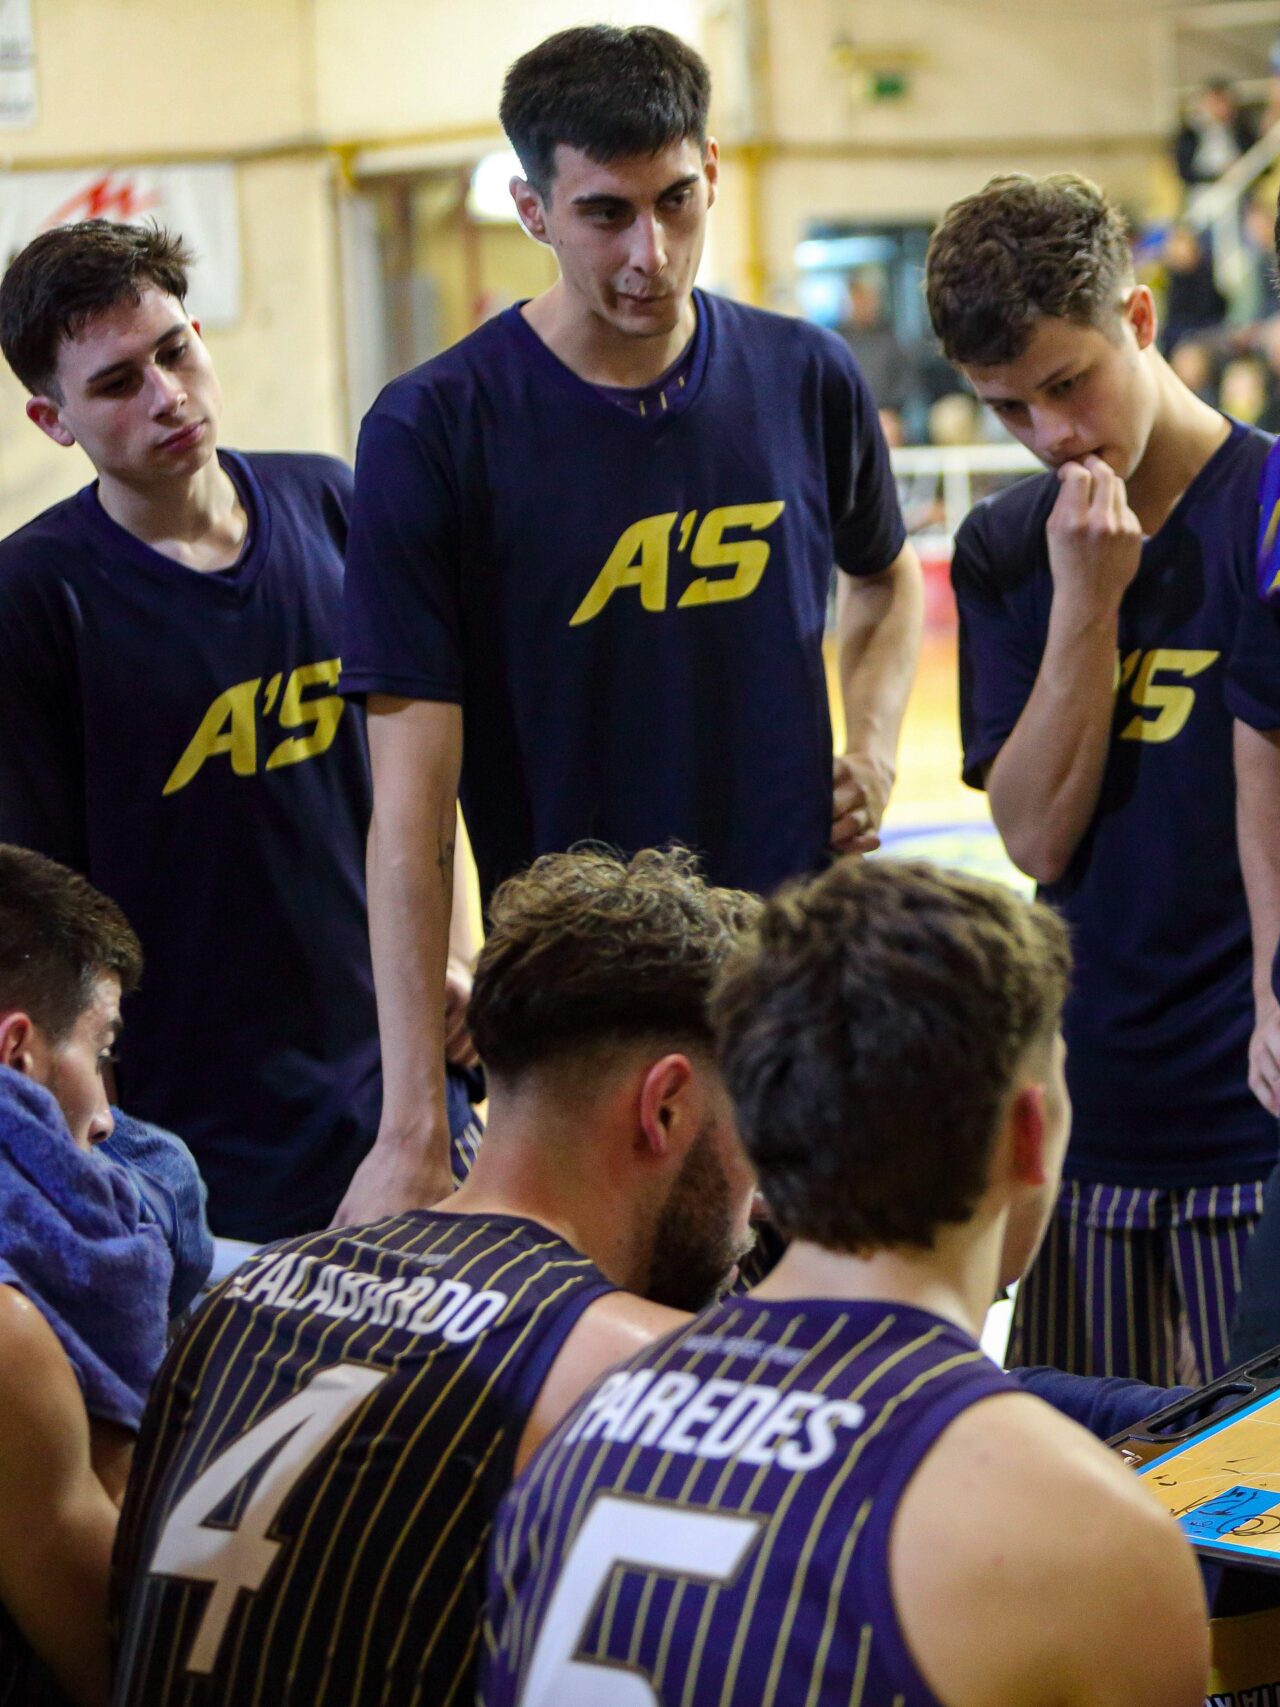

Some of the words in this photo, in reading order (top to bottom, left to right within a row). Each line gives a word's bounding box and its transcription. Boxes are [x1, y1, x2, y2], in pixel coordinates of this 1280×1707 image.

[569, 500, 786, 626] A'S
[162, 656, 345, 796] A'S
[563, 1368, 867, 1472] PAREDES
[147, 1360, 394, 1674] 4
